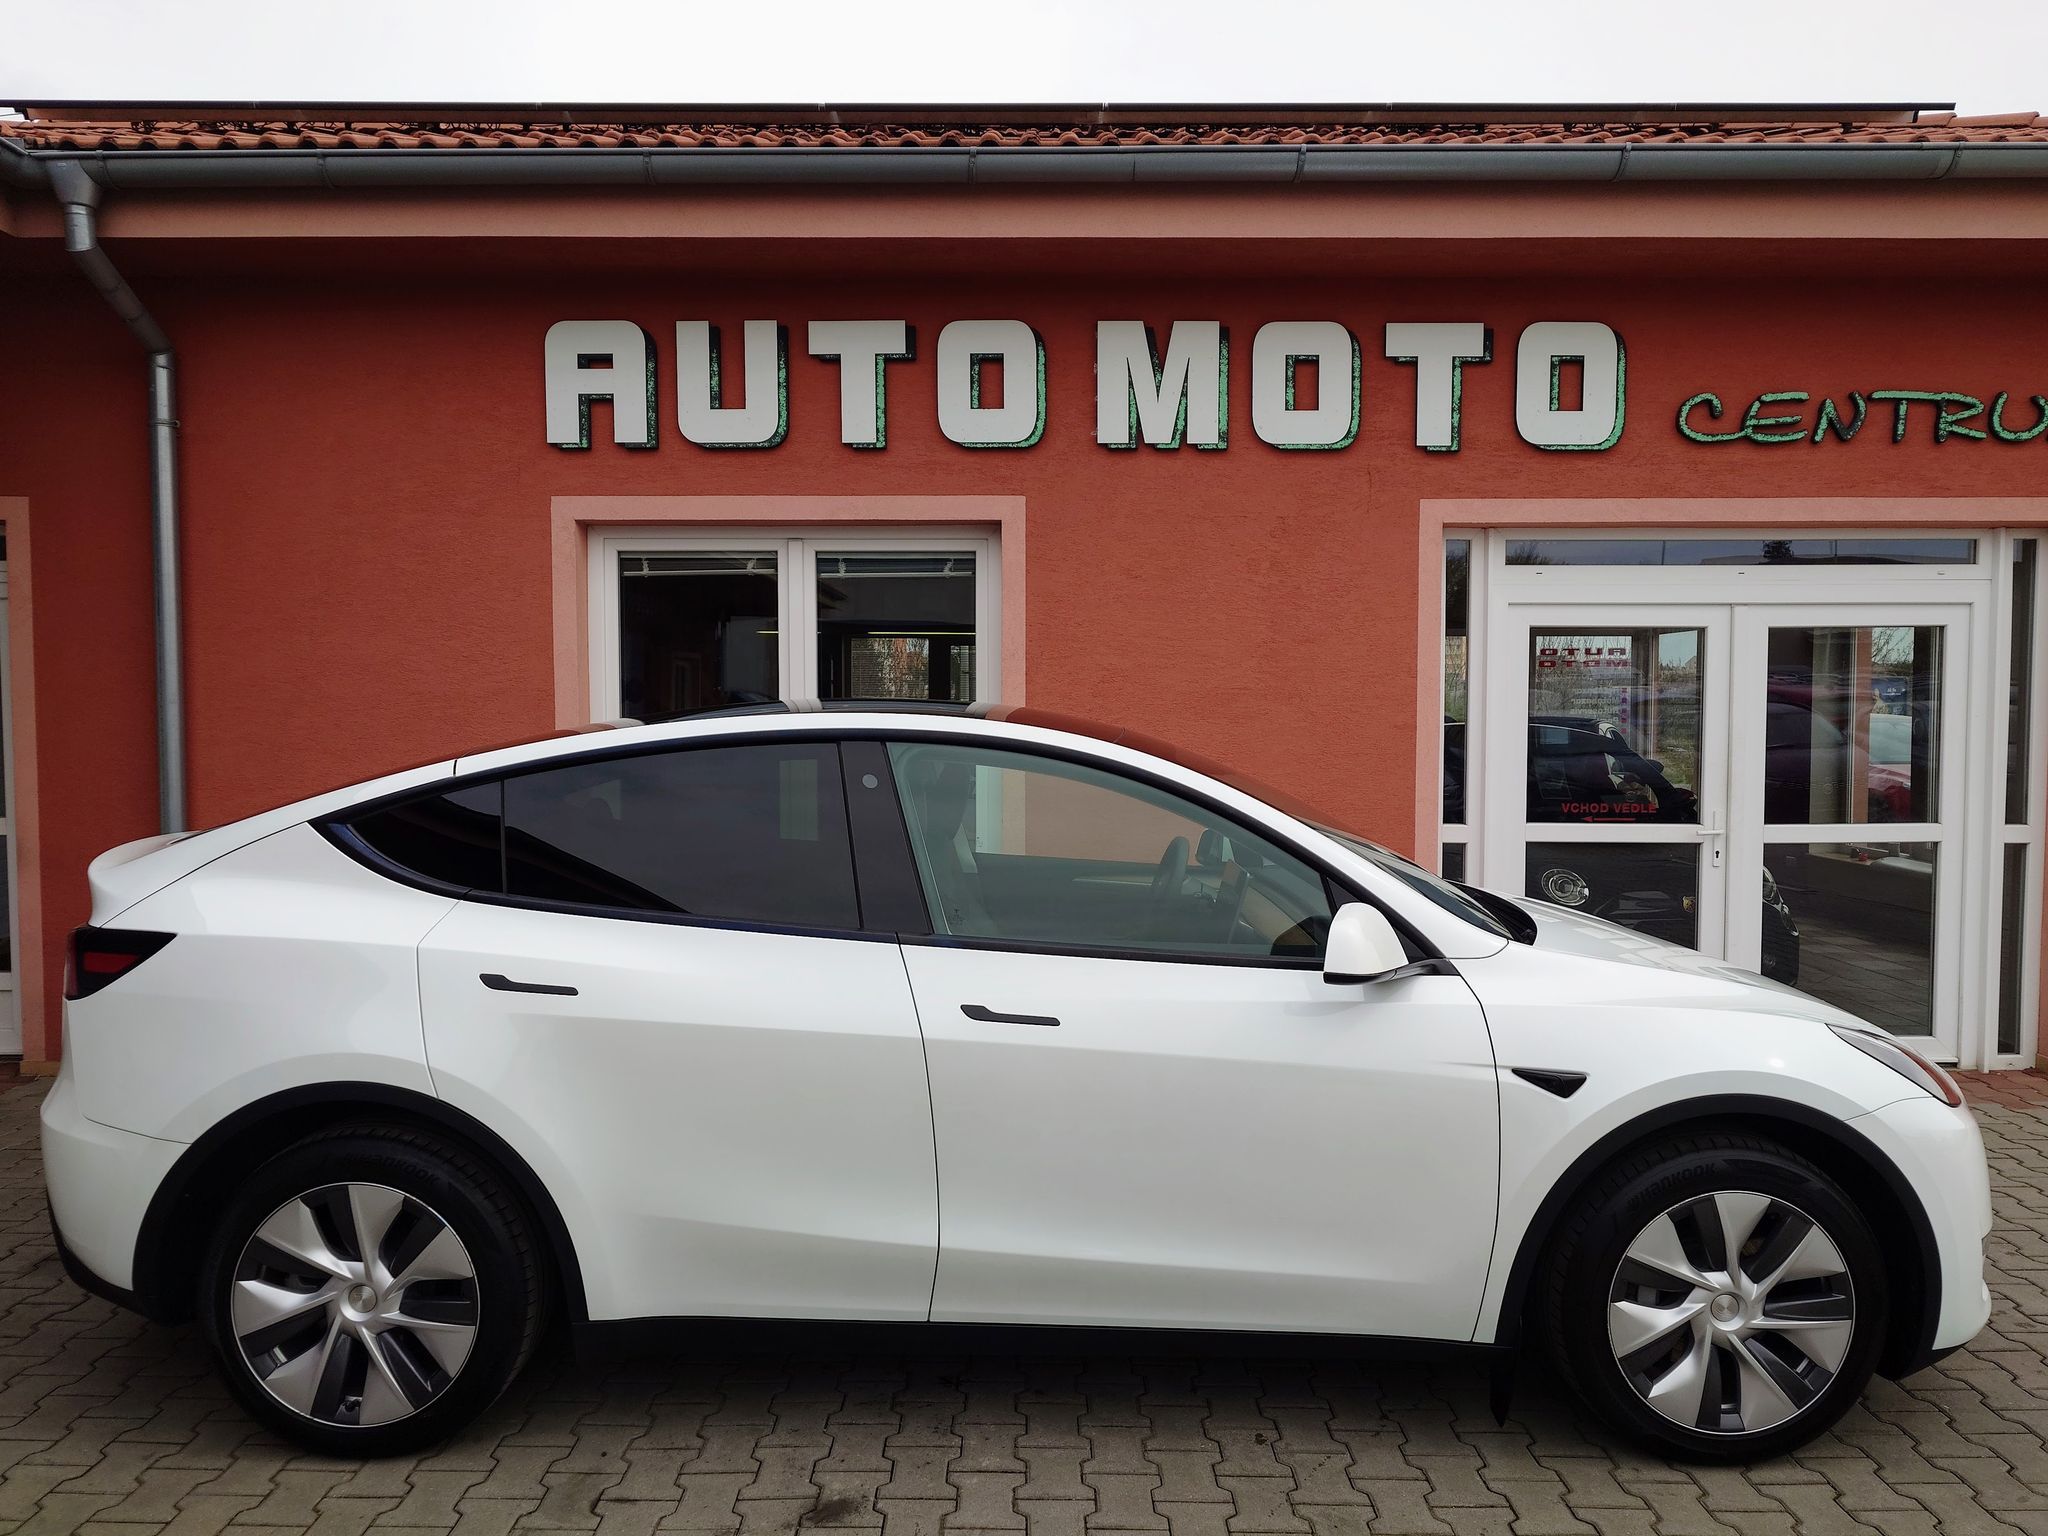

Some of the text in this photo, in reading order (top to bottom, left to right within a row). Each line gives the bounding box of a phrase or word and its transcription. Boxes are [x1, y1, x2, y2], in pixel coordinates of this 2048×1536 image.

[544, 319, 2048, 451] AUTO MOTO CENTRU
[1561, 803, 1657, 813] VCHOD VEDLE
